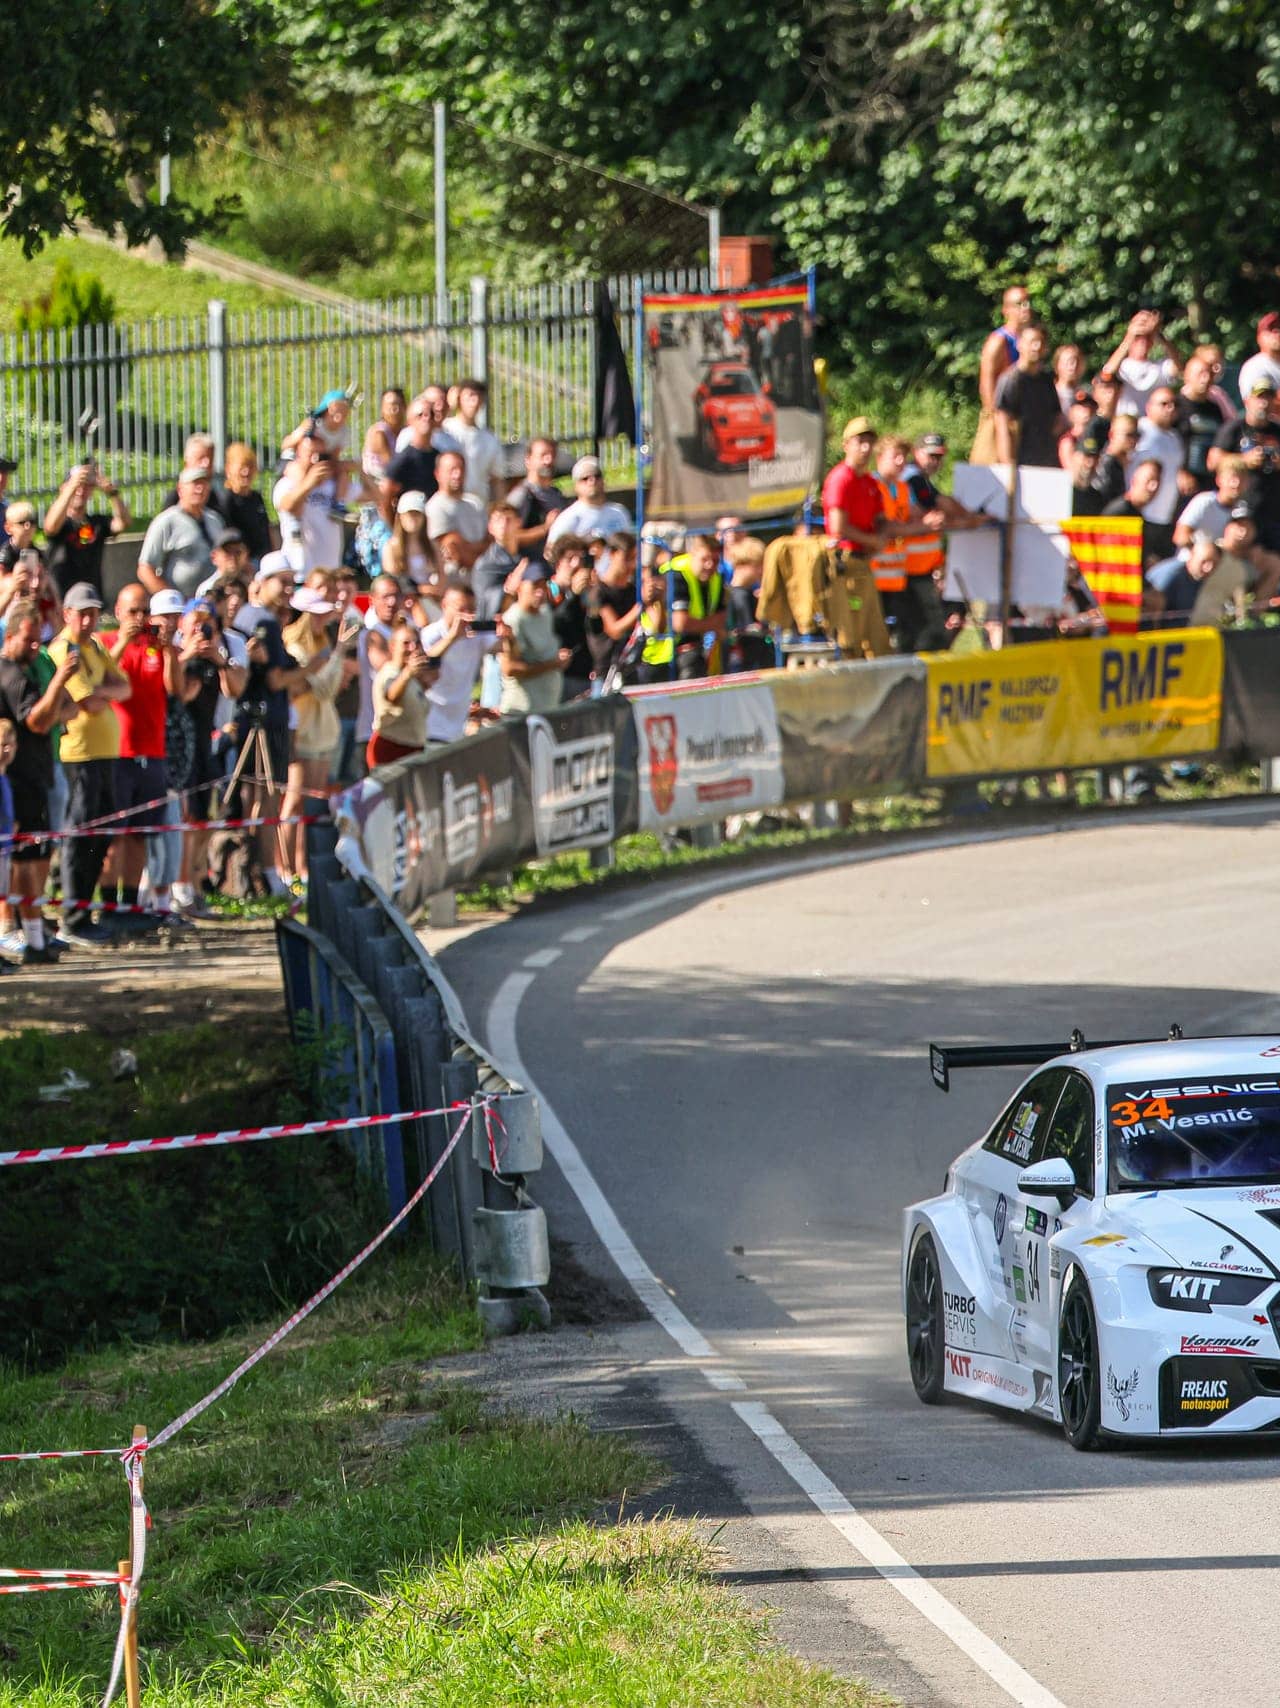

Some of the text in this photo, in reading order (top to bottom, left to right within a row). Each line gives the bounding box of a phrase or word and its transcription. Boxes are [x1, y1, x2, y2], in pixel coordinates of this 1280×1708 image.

[1100, 643, 1184, 712] RMF
[936, 679, 992, 728] RMF
[1110, 1097, 1174, 1128] 34
[1121, 1107, 1253, 1141] M. Vesnić
[1170, 1274, 1222, 1301] KIT
[944, 1291, 976, 1315] TURBO
[1185, 1334, 1261, 1347] formula
[1180, 1380, 1229, 1398] FREAKS
[1180, 1398, 1230, 1411] motorsport
